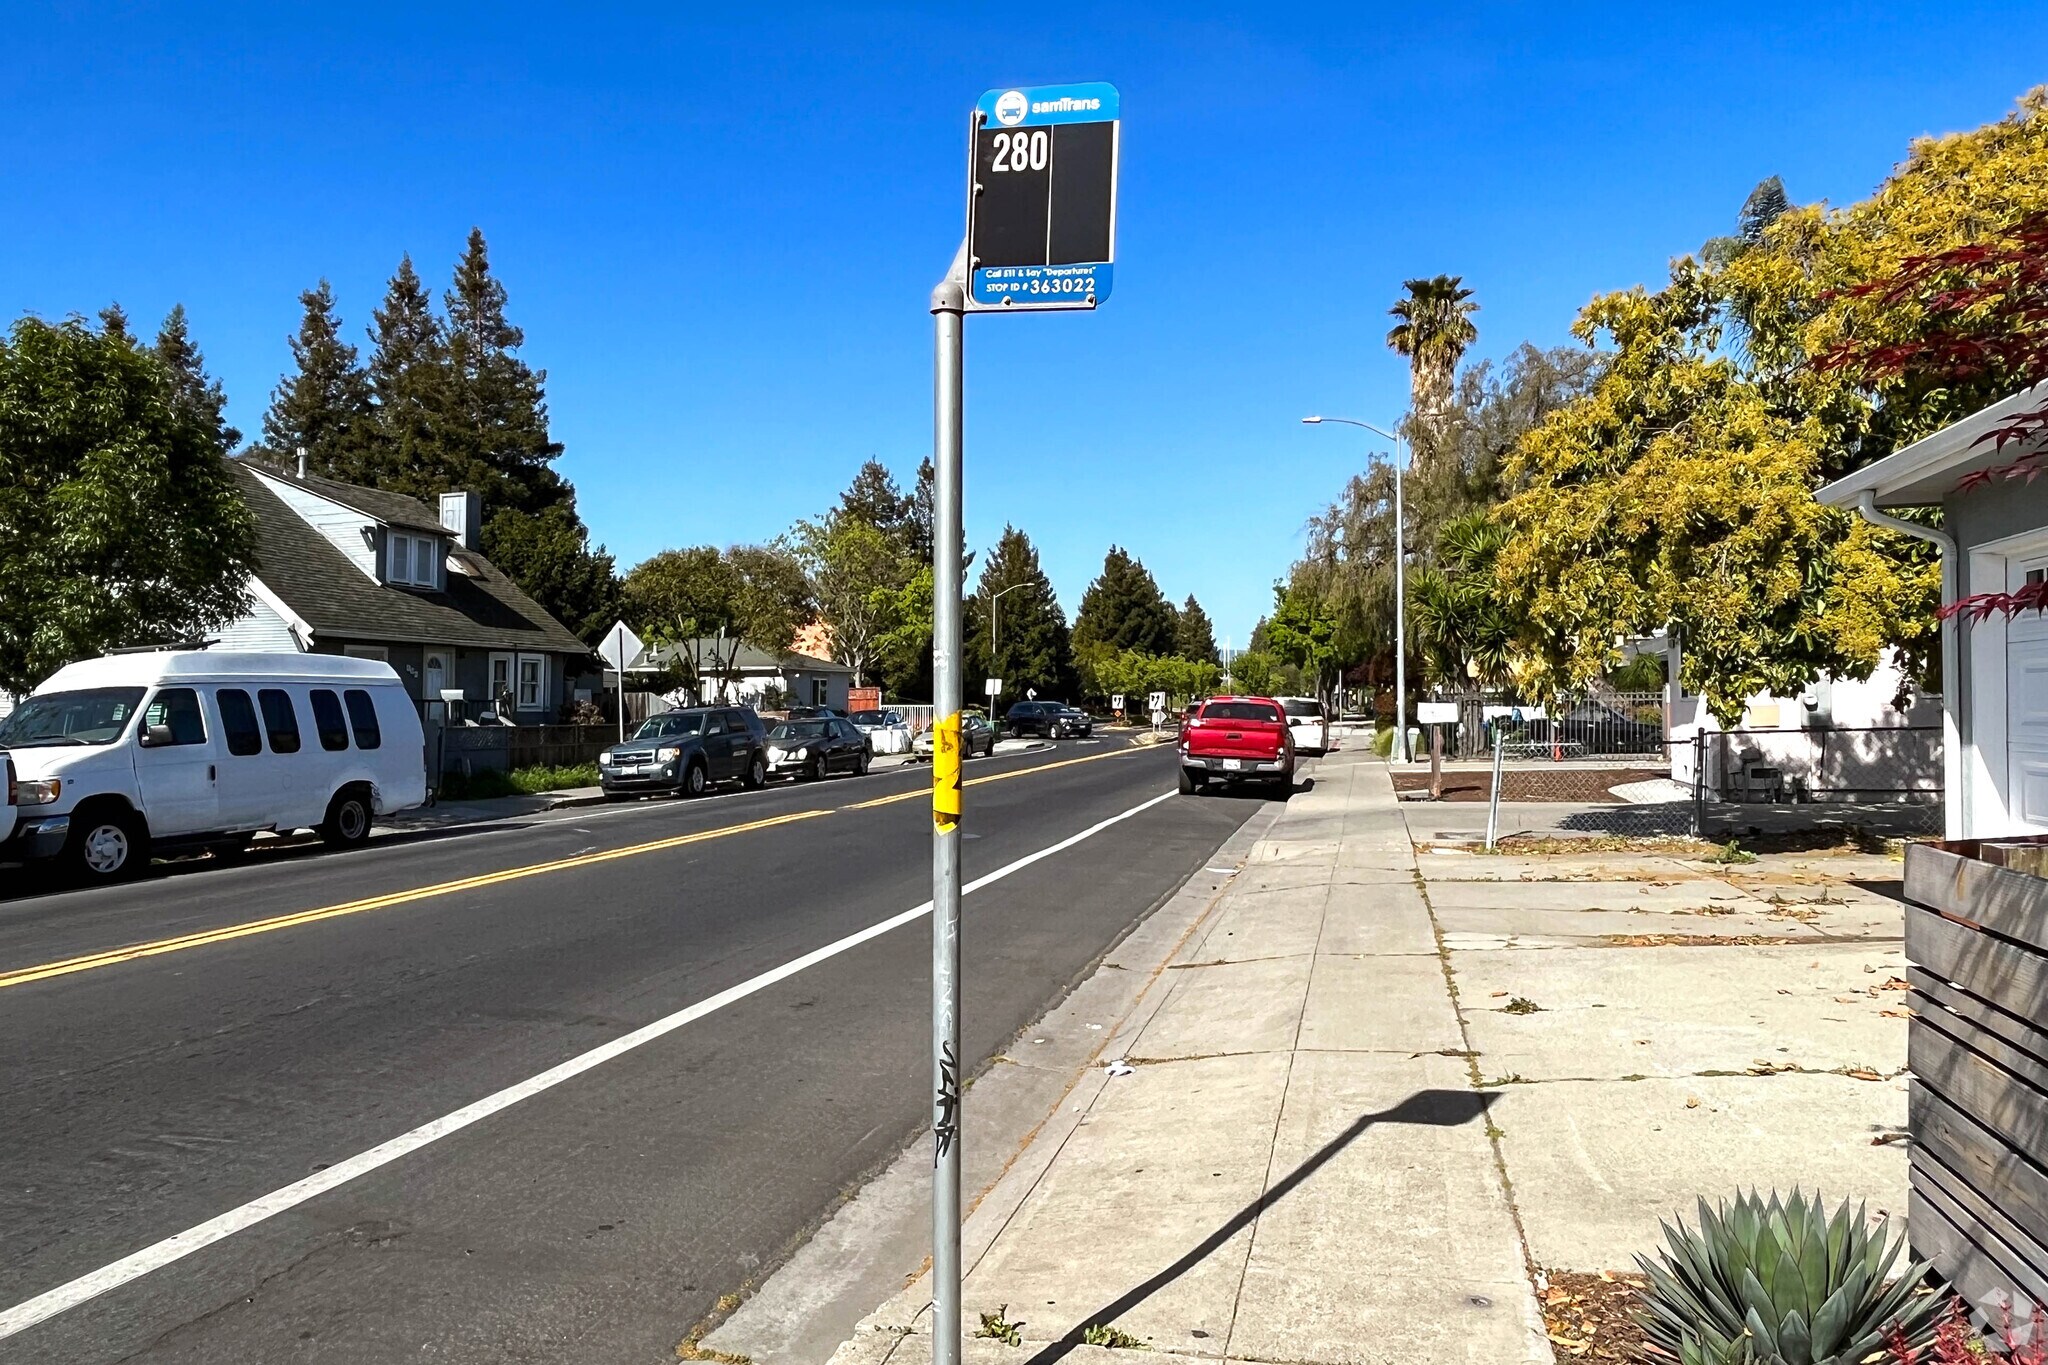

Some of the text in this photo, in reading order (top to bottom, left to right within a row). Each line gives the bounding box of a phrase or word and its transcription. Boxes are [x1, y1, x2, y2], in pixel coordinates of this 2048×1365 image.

[1032, 97, 1100, 114] samTrans
[992, 130, 1048, 172] 280
[985, 269, 1002, 278] Call
[1003, 269, 1016, 278] 511
[1018, 269, 1024, 277] &
[1026, 268, 1042, 278] Say
[986, 277, 1095, 294] STOP ID # 363022
